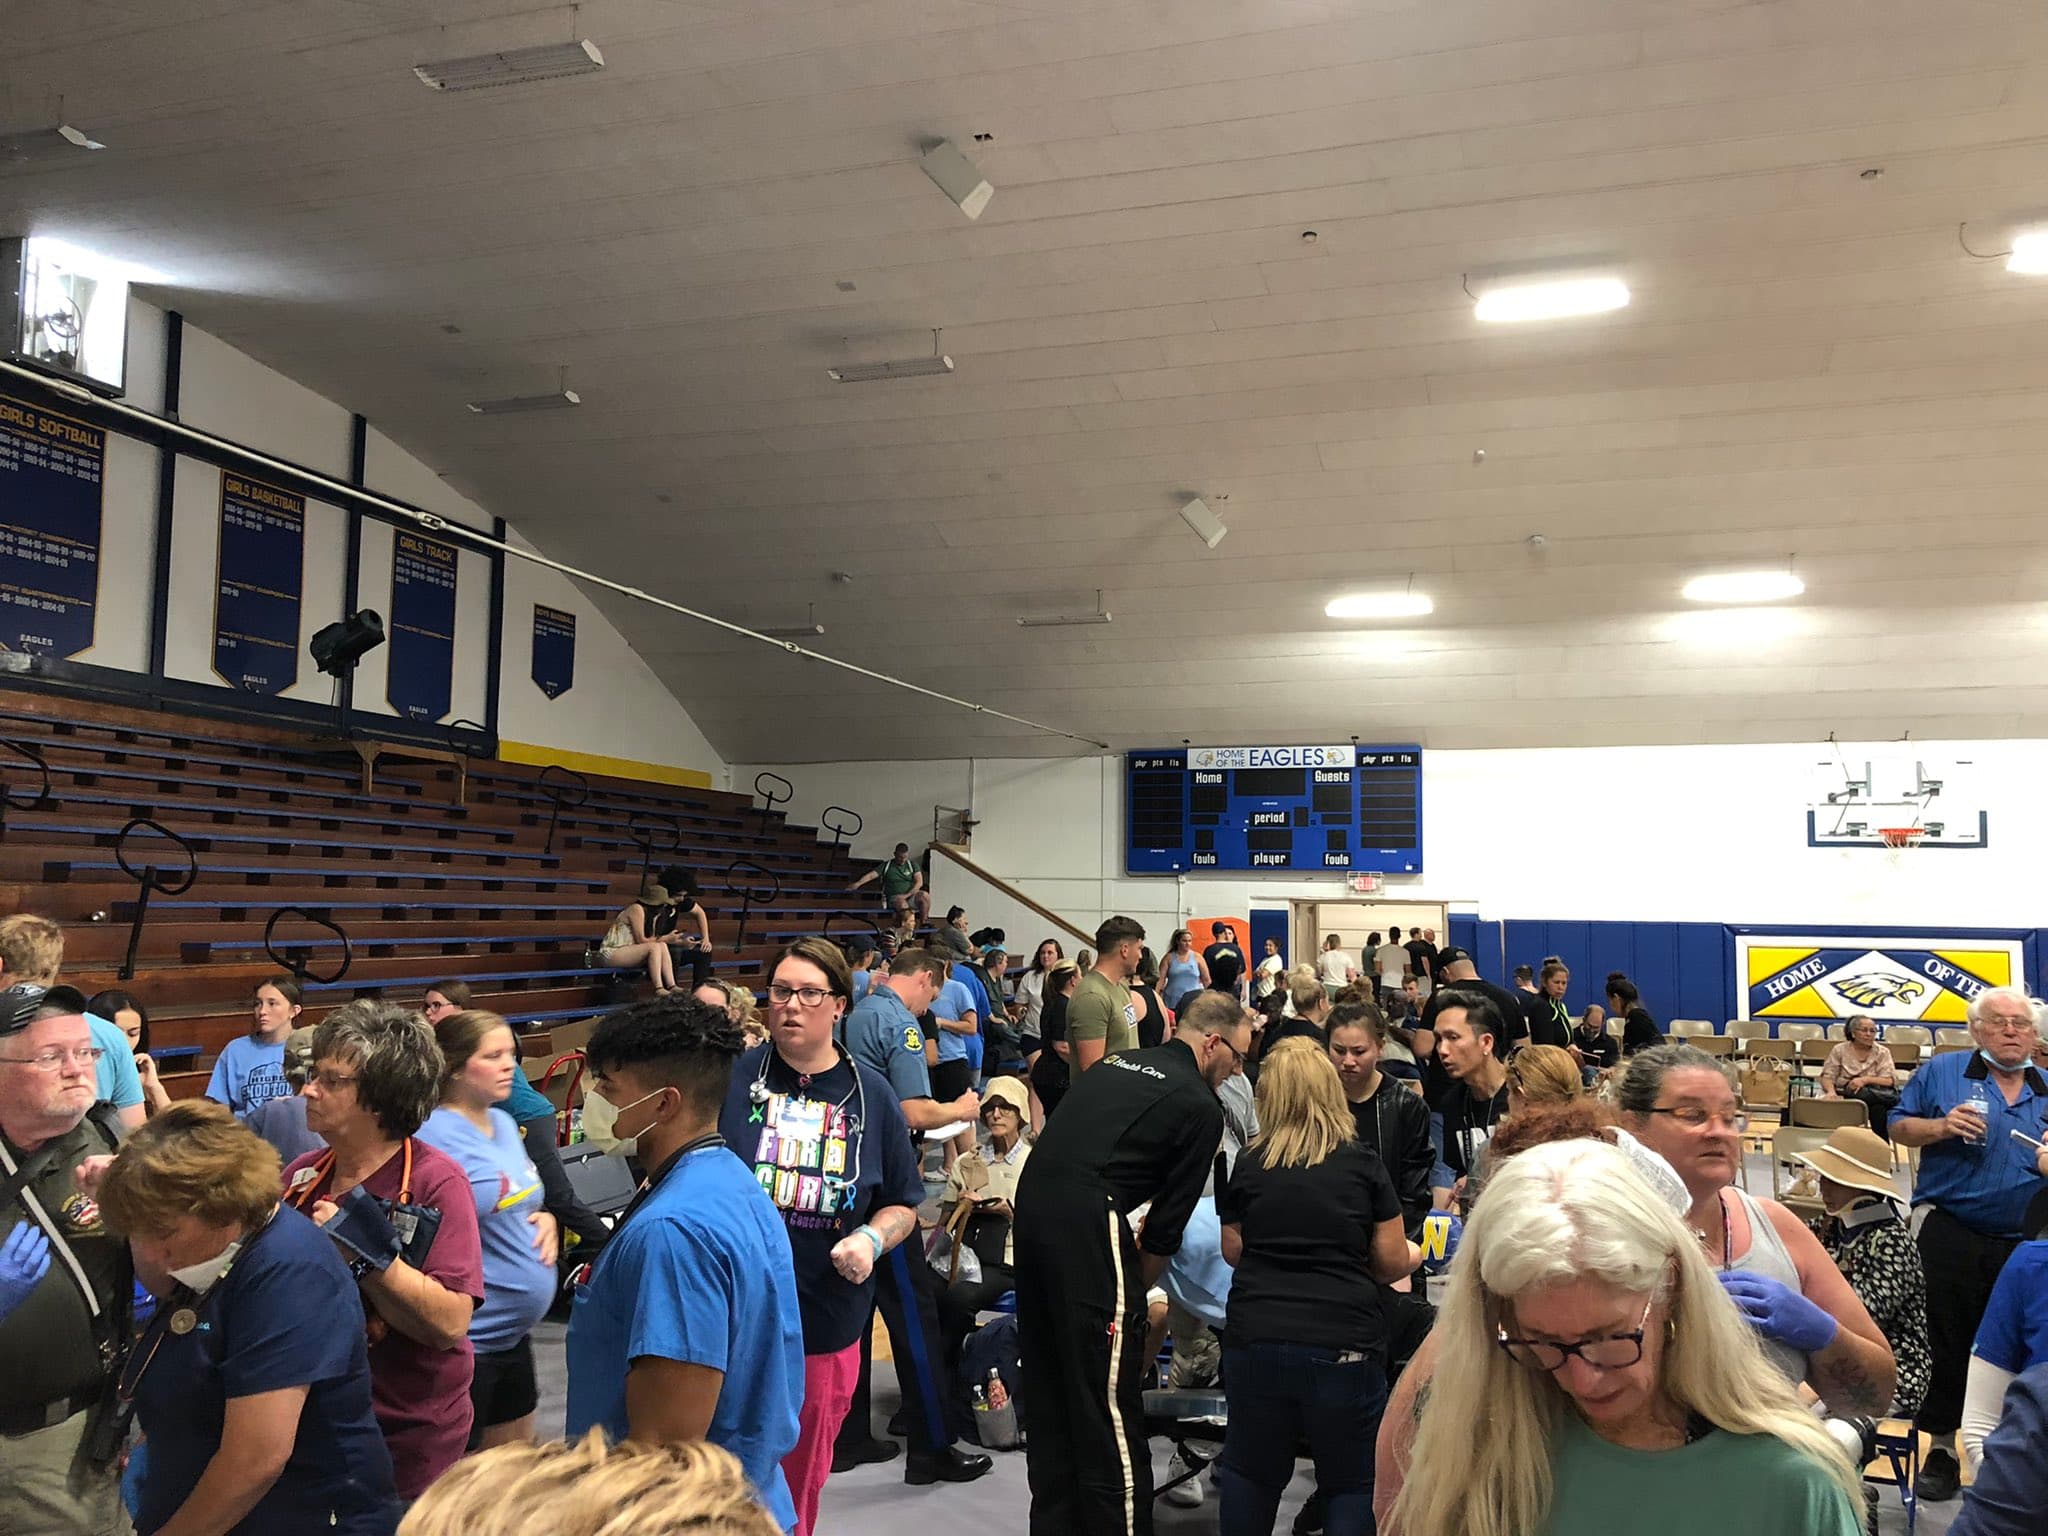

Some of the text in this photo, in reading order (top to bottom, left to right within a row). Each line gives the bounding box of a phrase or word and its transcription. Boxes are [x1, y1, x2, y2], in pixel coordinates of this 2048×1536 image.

[0, 404, 35, 429] GIRLS
[39, 417, 101, 449] SOFTBALL
[225, 479, 250, 497] GIRLS
[251, 487, 302, 514] BASKETBALL
[400, 536, 424, 553] GIRLS
[425, 544, 453, 563] TRACK
[20, 634, 54, 646] EAGLES
[1216, 749, 1244, 759] HOME
[1249, 748, 1325, 766] EAGLES
[1195, 772, 1222, 784] Home
[1315, 770, 1350, 782] Guests
[1254, 812, 1285, 825] period
[1193, 853, 1216, 864] fouls
[1254, 852, 1286, 866] player
[1325, 853, 1350, 865] fouls
[1764, 958, 1828, 999] HOME
[1924, 959, 1989, 998] OF TH
[1141, 1066, 1167, 1080] Care
[757, 1127, 843, 1169] FOR A
[756, 1166, 838, 1214] CURE
